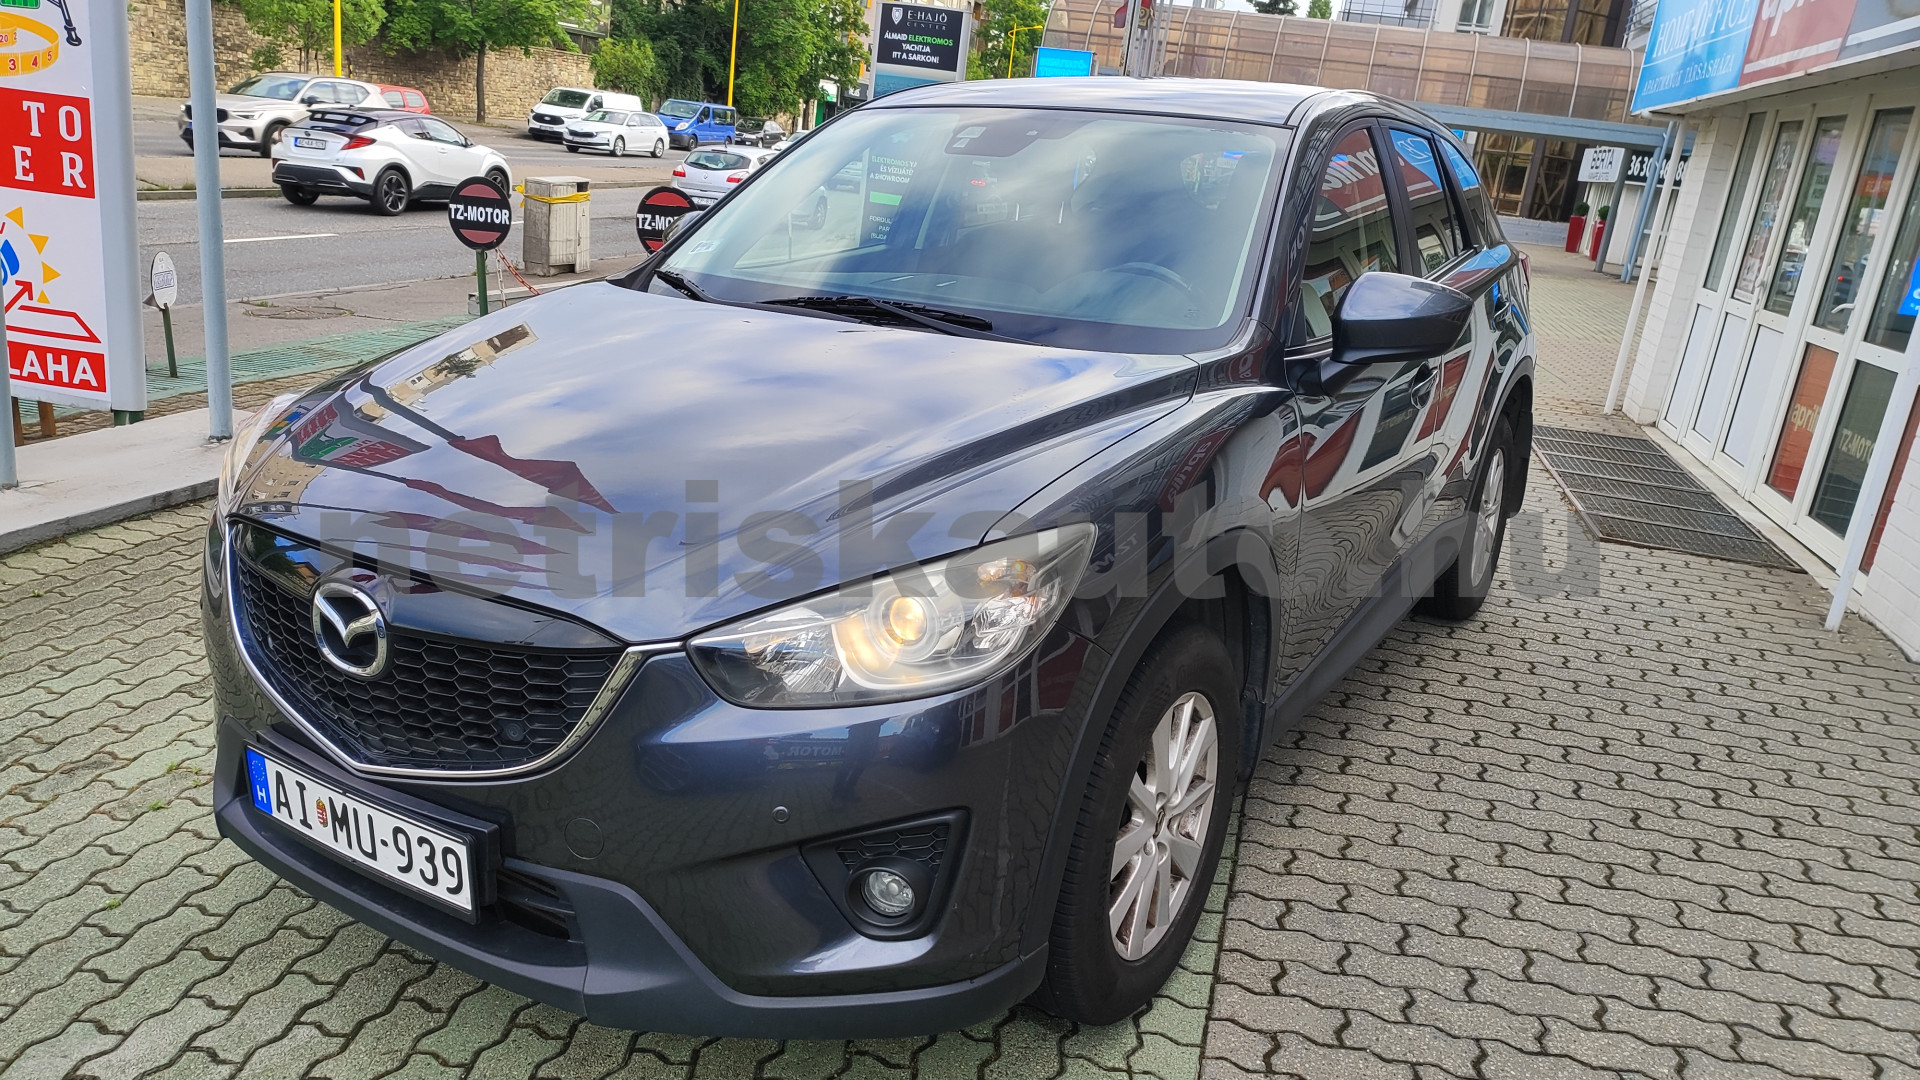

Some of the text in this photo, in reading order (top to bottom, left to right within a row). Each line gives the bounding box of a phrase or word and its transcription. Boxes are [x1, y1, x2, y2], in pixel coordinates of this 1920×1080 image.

[906, 21, 946, 31] CENTER
[908, 34, 954, 47] ELEKTROMOS
[8, 50, 53, 71] 3 4 5
[449, 203, 510, 225] TZ-MOTOR
[636, 213, 680, 231] TZ-MO
